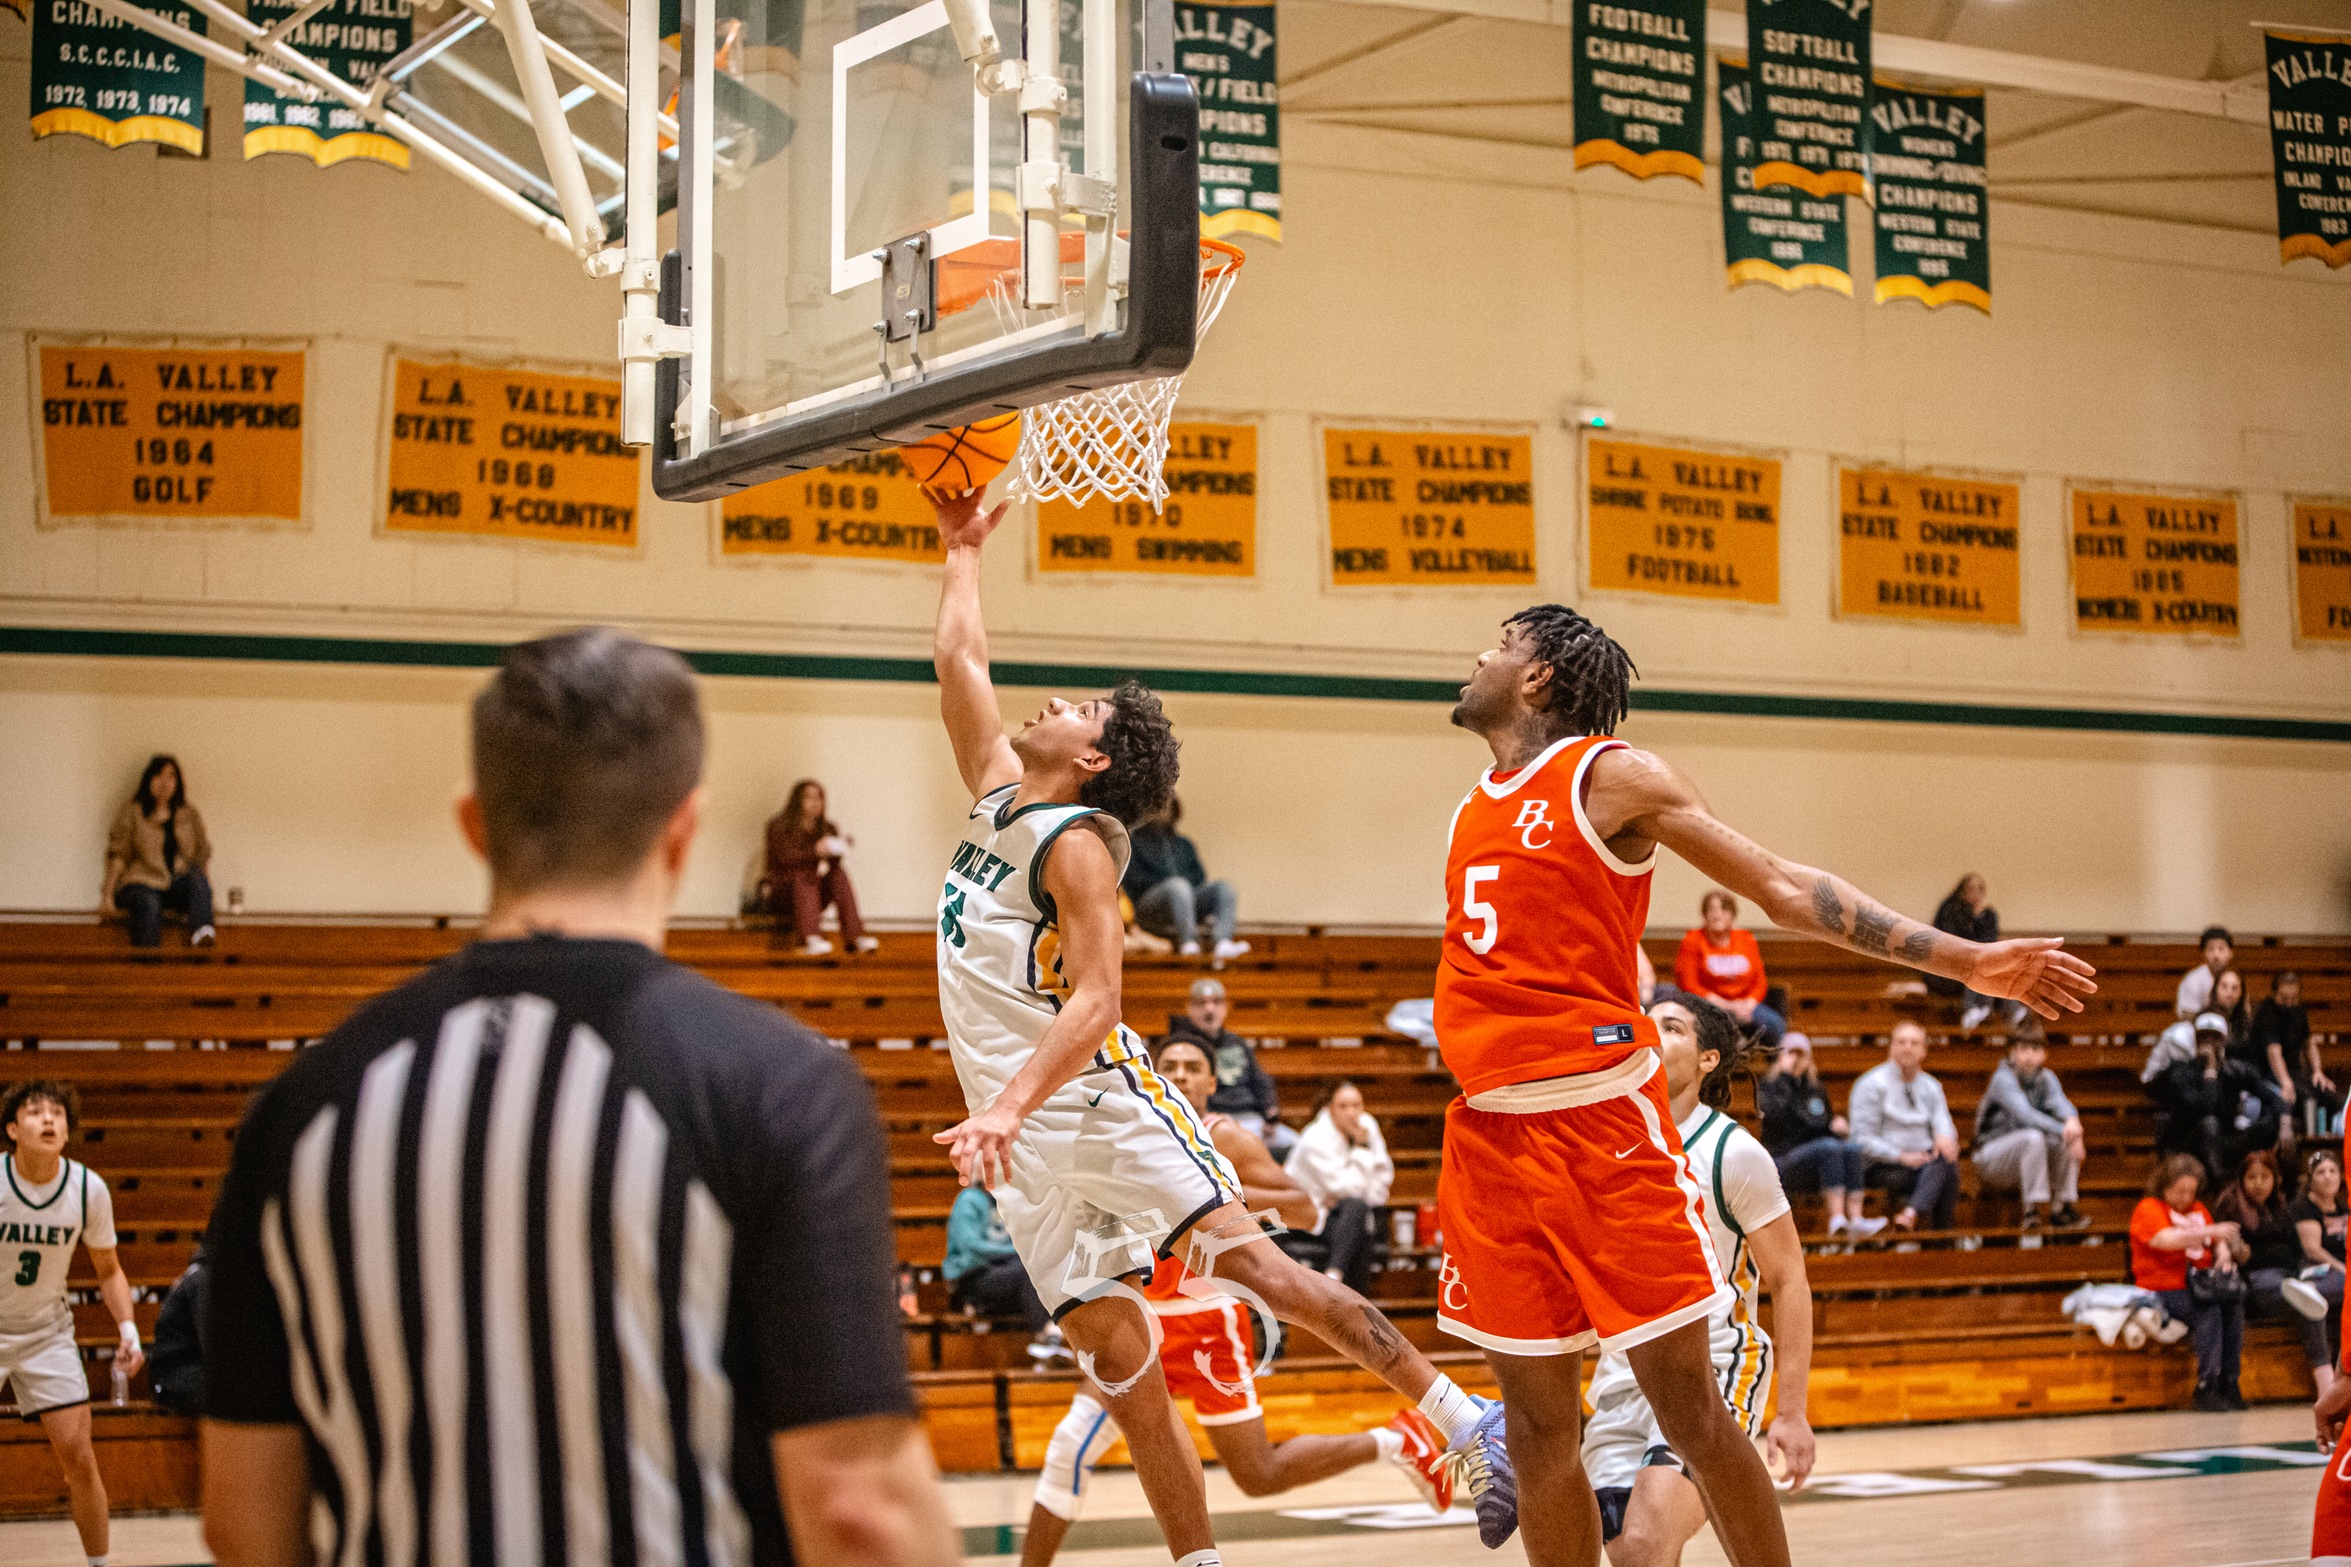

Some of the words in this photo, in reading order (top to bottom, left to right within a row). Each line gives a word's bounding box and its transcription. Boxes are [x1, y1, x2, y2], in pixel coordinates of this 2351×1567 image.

[1588, 3, 1691, 42] FOOTBALL
[1585, 36, 1696, 76] CHAMPIONS
[1762, 28, 1860, 65] SOFTBALL
[1760, 61, 1865, 98] CHAMPIONS
[1871, 97, 1983, 146] VALLEY
[2272, 109, 2324, 134] WATER
[1879, 183, 1979, 216] CHAMPIONS
[65, 362, 126, 390] L.A.
[157, 362, 278, 392] VALLEY
[43, 398, 128, 426] STATE
[156, 401, 301, 430] CHAMPIONS
[505, 384, 621, 420] VALLEY
[393, 412, 475, 446] STATE
[135, 438, 214, 466] 1964
[1414, 444, 1512, 471] VALLEY
[133, 474, 214, 504] GOLF
[1327, 475, 1396, 502] STATE
[1417, 479, 1533, 506] CHAMPIONS
[1672, 459, 1763, 494] VALLEY
[489, 494, 633, 534] X-COUNTRY
[1918, 487, 2003, 519] VALLEY
[816, 517, 941, 551] X-COUNTR
[1401, 513, 1466, 539] 1974
[1841, 512, 1900, 541] STATE
[1919, 519, 2018, 552] CHAMPIONS
[2145, 506, 2221, 535] VALLEY
[1409, 548, 1535, 574] VOLLEYBALL
[2074, 533, 2127, 560] STATE
[2145, 537, 2238, 568] CHAMPIONS
[1626, 552, 1741, 588] FOOTBALL
[1876, 578, 1985, 613] BASEBALL
[1462, 865, 1500, 955] 5
[15, 1250, 41, 1286] 3
